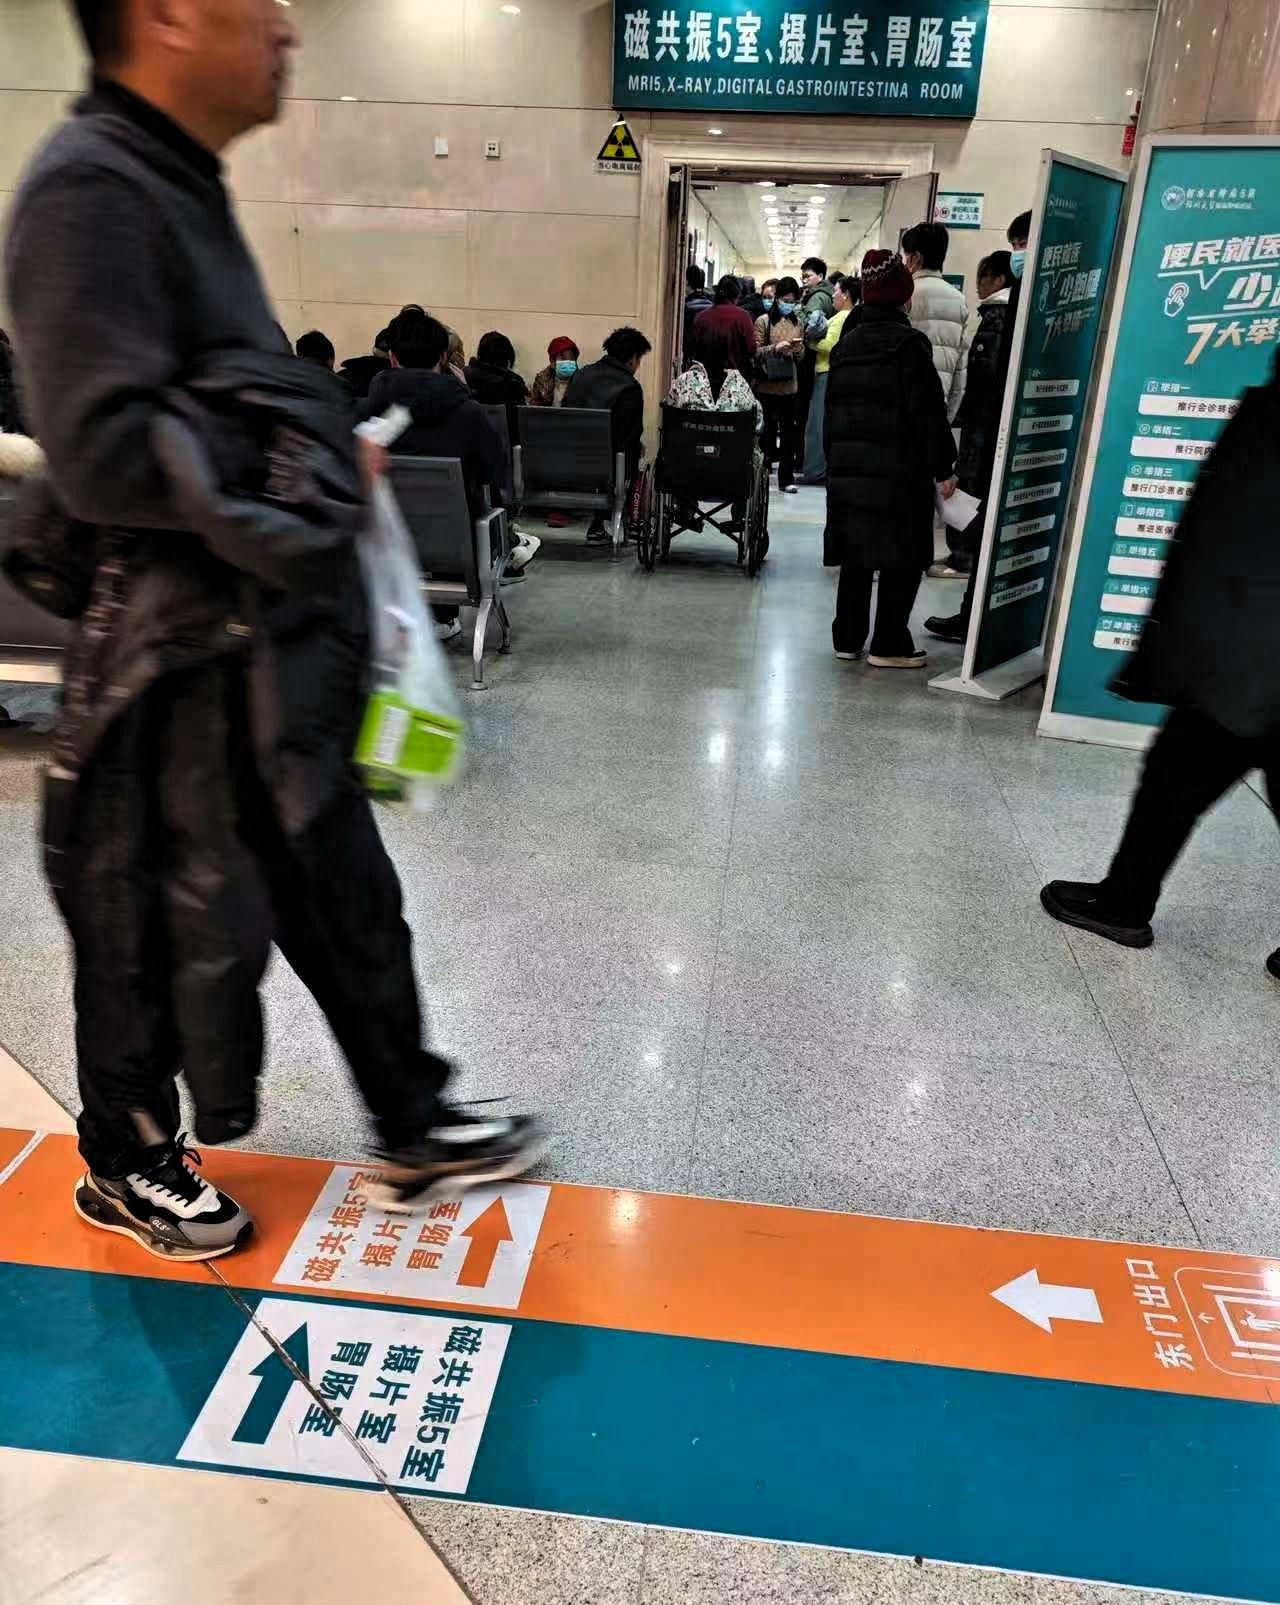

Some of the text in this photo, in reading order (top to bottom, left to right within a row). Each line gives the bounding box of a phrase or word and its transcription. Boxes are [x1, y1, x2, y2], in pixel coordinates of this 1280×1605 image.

[624, 10, 977, 69] 磁共振5室、摄片室、胃肠室
[776, 79, 909, 98] GASTROINTESTINA
[920, 83, 963, 100] ROOM
[1160, 234, 1280, 270] 便民就医
[1223, 271, 1280, 311] 少
[1184, 317, 1280, 365] 7大举
[360, 1206, 413, 1267] 摄片
[406, 1200, 463, 1269] 胃肠室
[1125, 1258, 1196, 1371] 东门出口
[298, 1341, 372, 1437] 胃肠室
[354, 1344, 424, 1443] 摄片室
[400, 1325, 483, 1482] 磁共振5室
